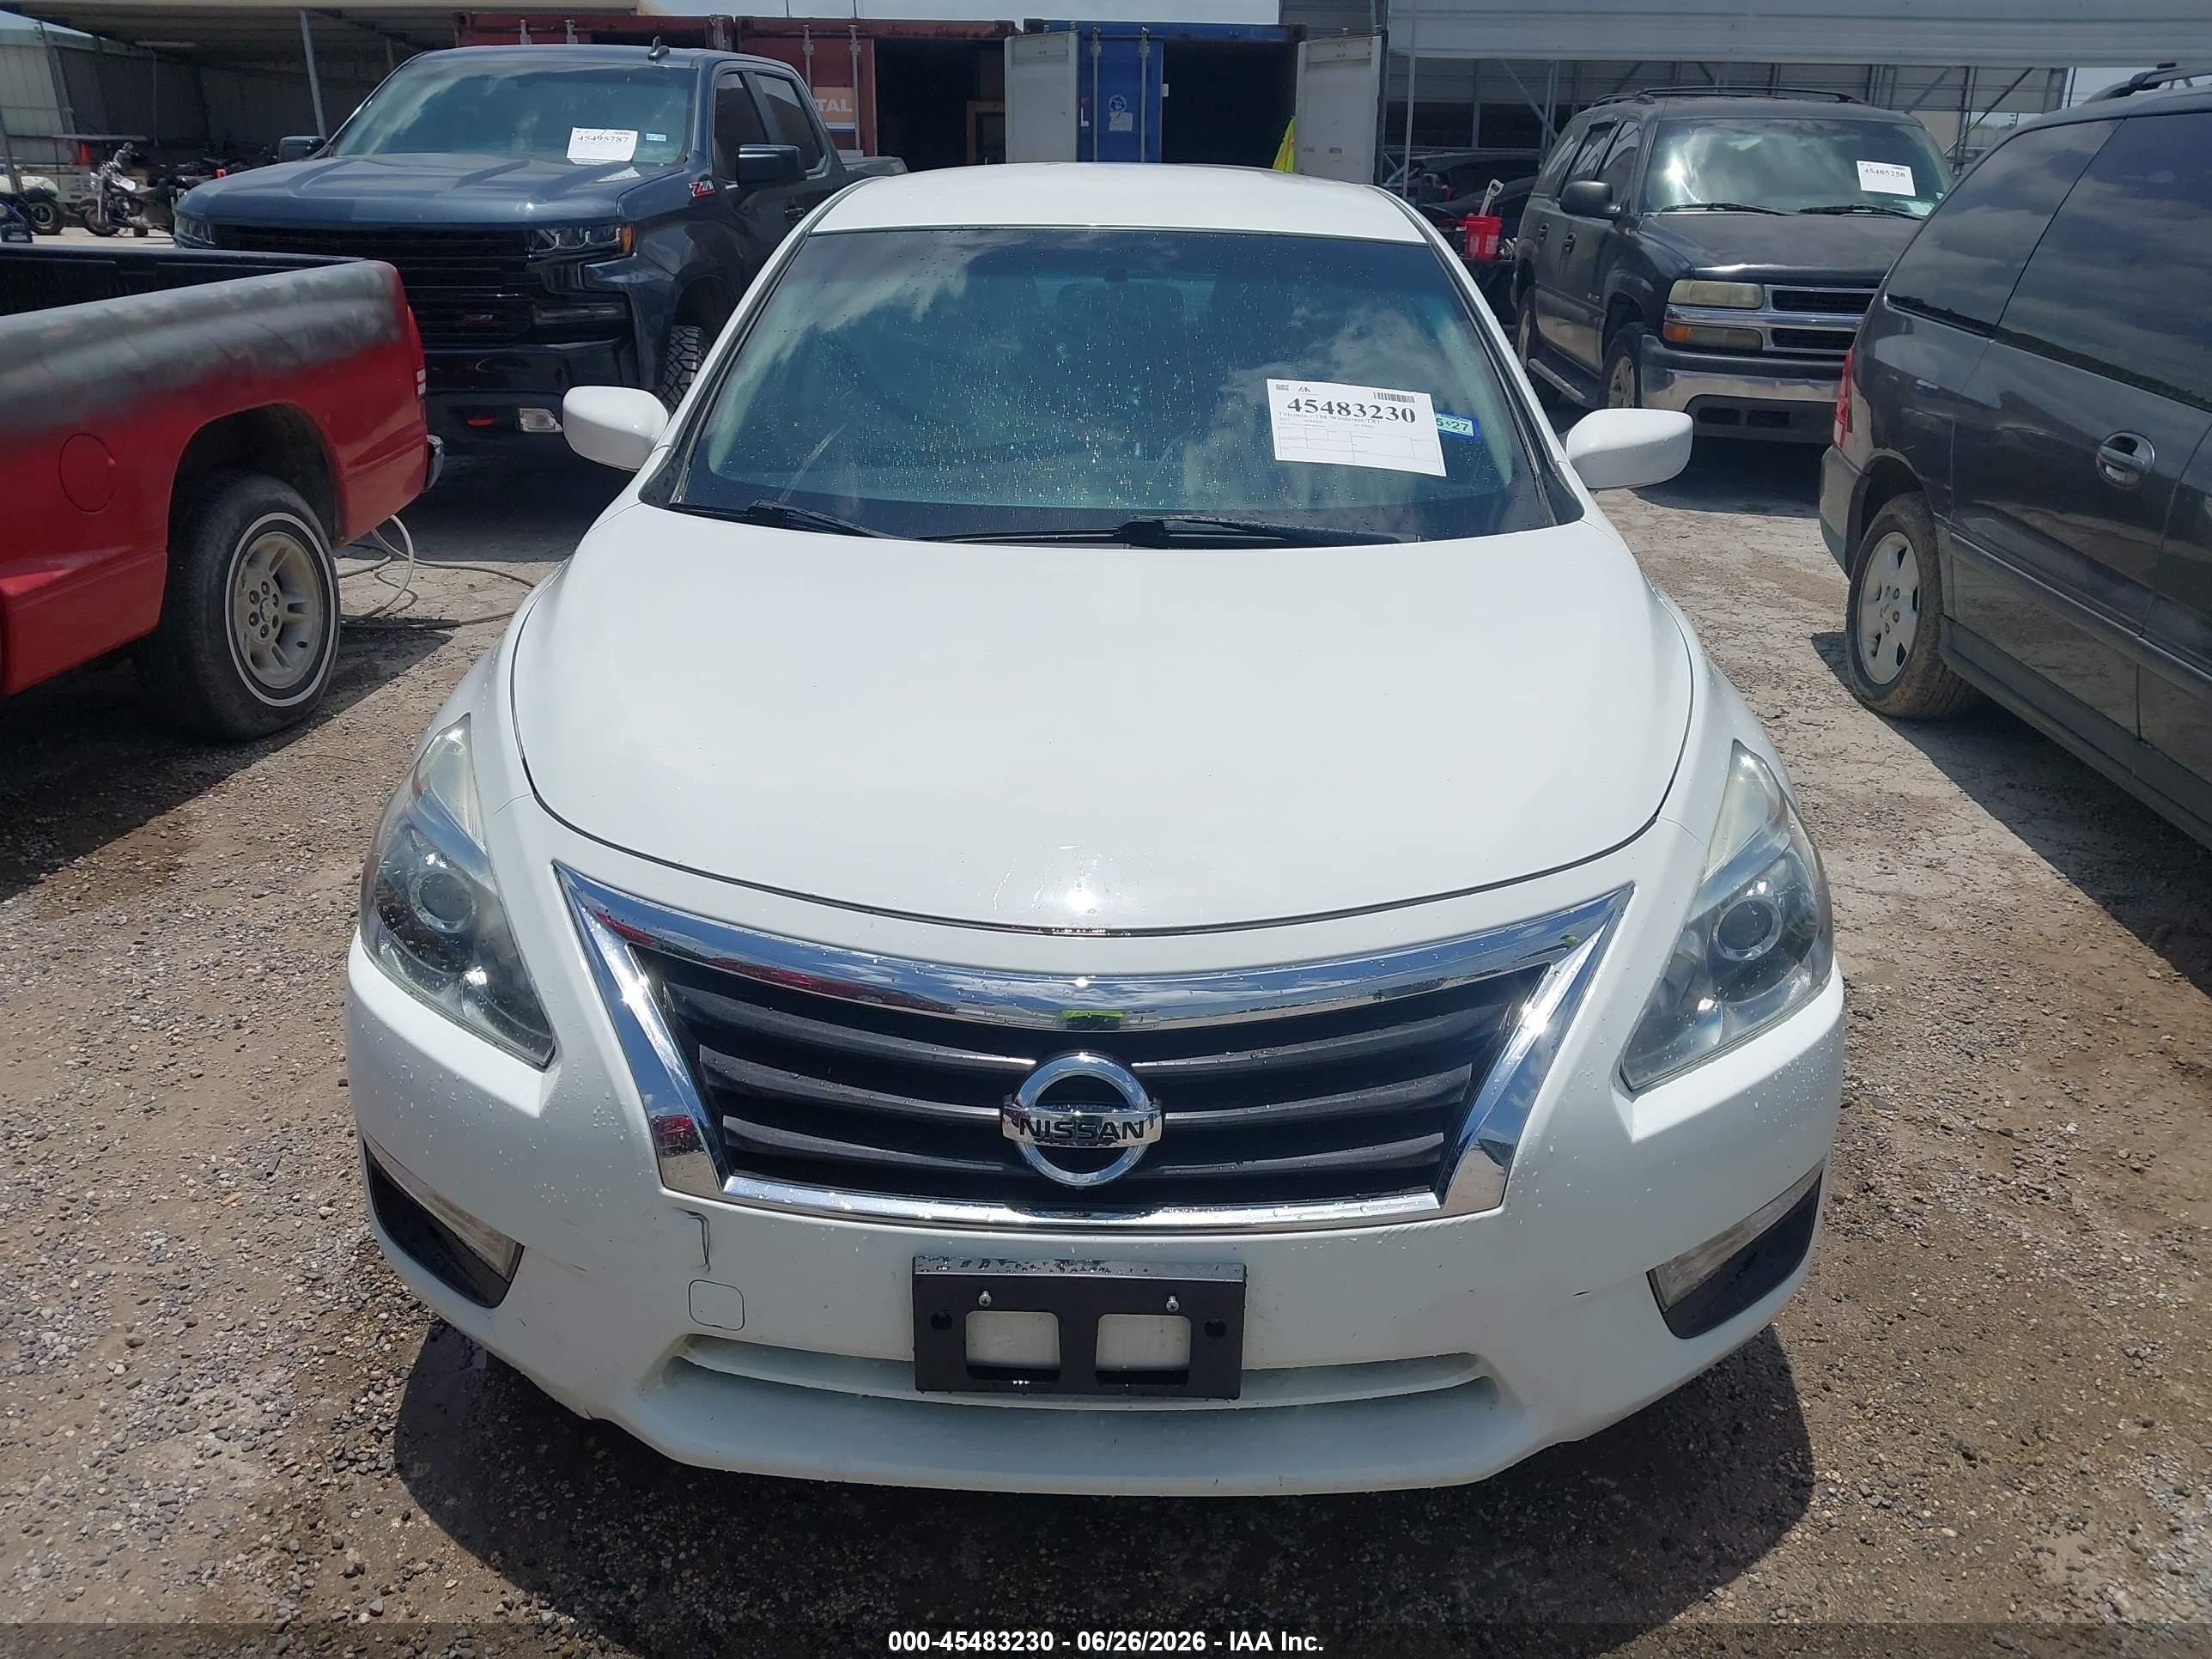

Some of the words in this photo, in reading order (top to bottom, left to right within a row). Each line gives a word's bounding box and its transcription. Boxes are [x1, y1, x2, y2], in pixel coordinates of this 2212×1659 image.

[814, 99, 852, 112] TAL
[1287, 398, 1416, 423] 45483230
[1019, 1118, 1145, 1140] NISSAN
